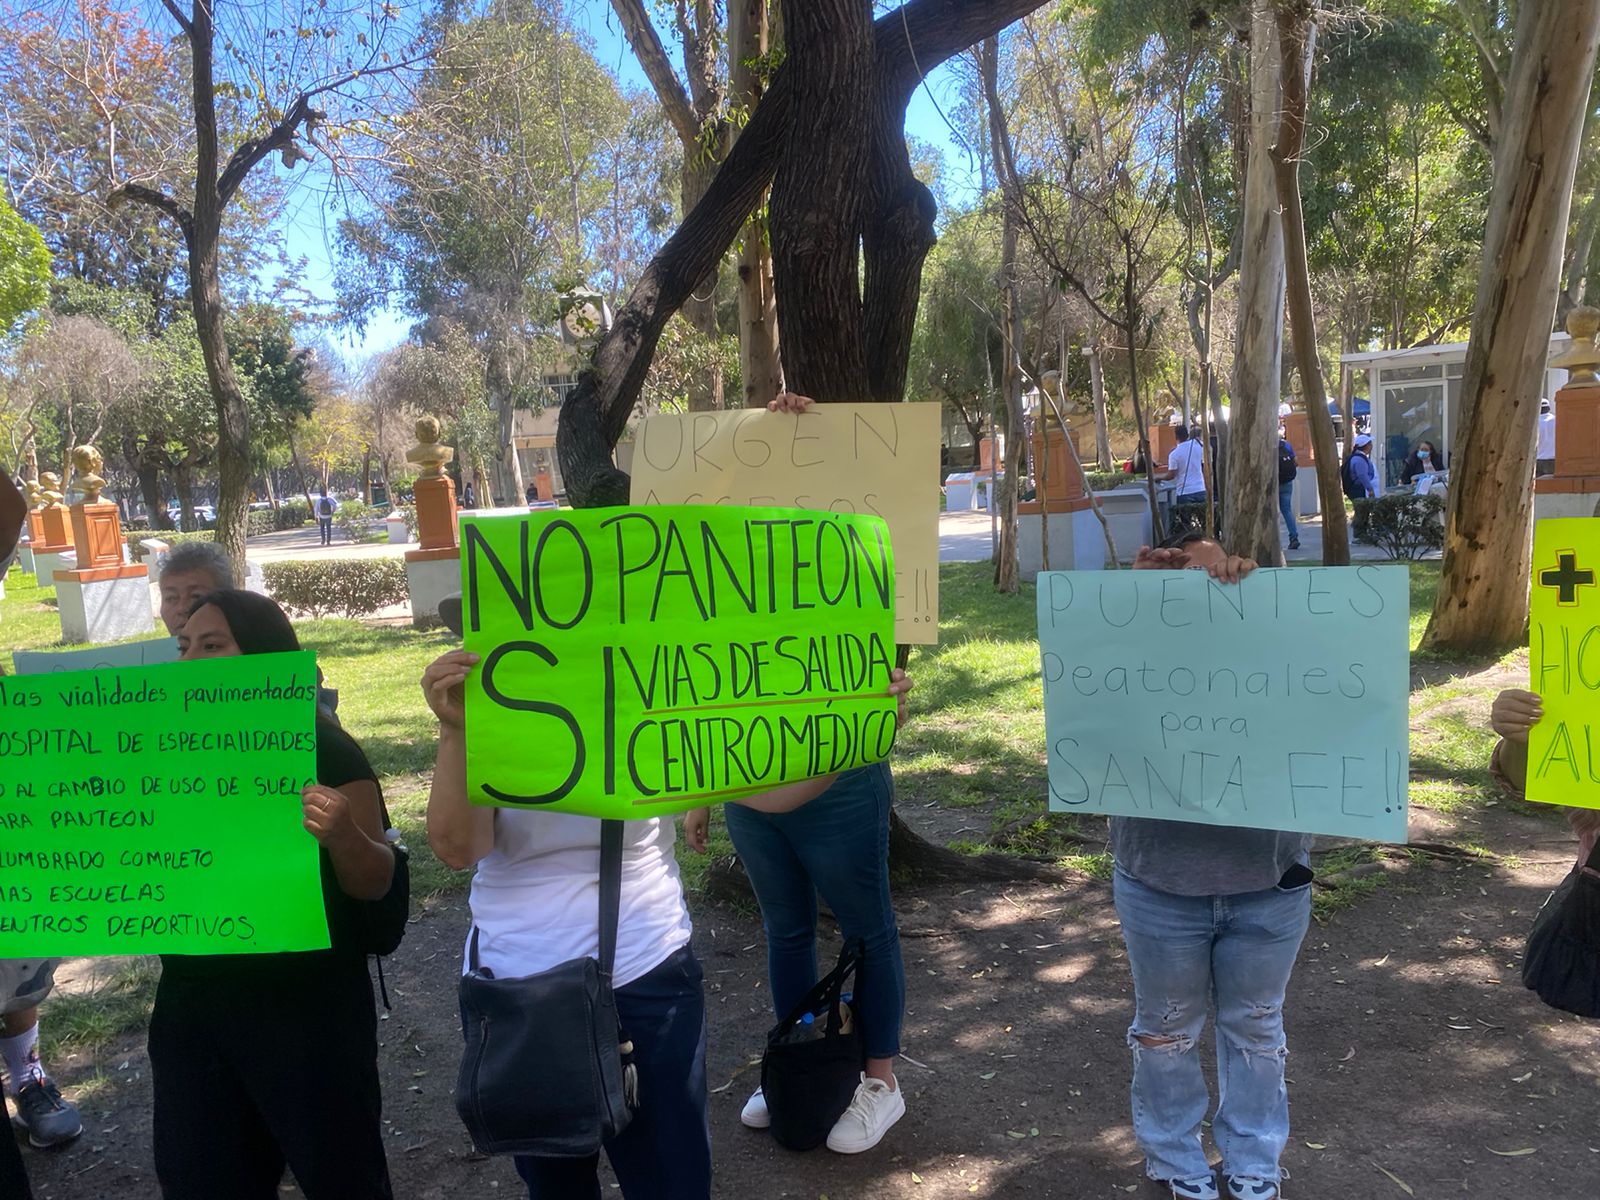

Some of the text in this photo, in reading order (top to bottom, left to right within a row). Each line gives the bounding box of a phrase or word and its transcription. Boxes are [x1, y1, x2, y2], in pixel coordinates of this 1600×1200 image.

[641, 410, 900, 473] URGEN
[464, 512, 891, 632] NO PANTEÓN
[1048, 564, 1385, 628] PUENTES
[58, 675, 168, 708] vialidades
[184, 673, 316, 713] pavimentadas
[618, 632, 892, 712] VIAS DE SALIDA
[118, 731, 144, 754] DE
[480, 639, 616, 804] SI
[1160, 711, 1249, 749] para
[627, 700, 898, 796] CENTRO MÉDICO
[16, 782, 36, 798] AL
[48, 776, 126, 797] CAMBIO
[141, 775, 163, 796] DE
[170, 776, 206, 795] USO
[217, 776, 240, 797] DE
[1048, 737, 1403, 819] SANTA FE!!
[51, 809, 155, 829] PANTEON
[120, 848, 214, 870] COMPLETO
[50, 883, 166, 903] ESCUELAS
